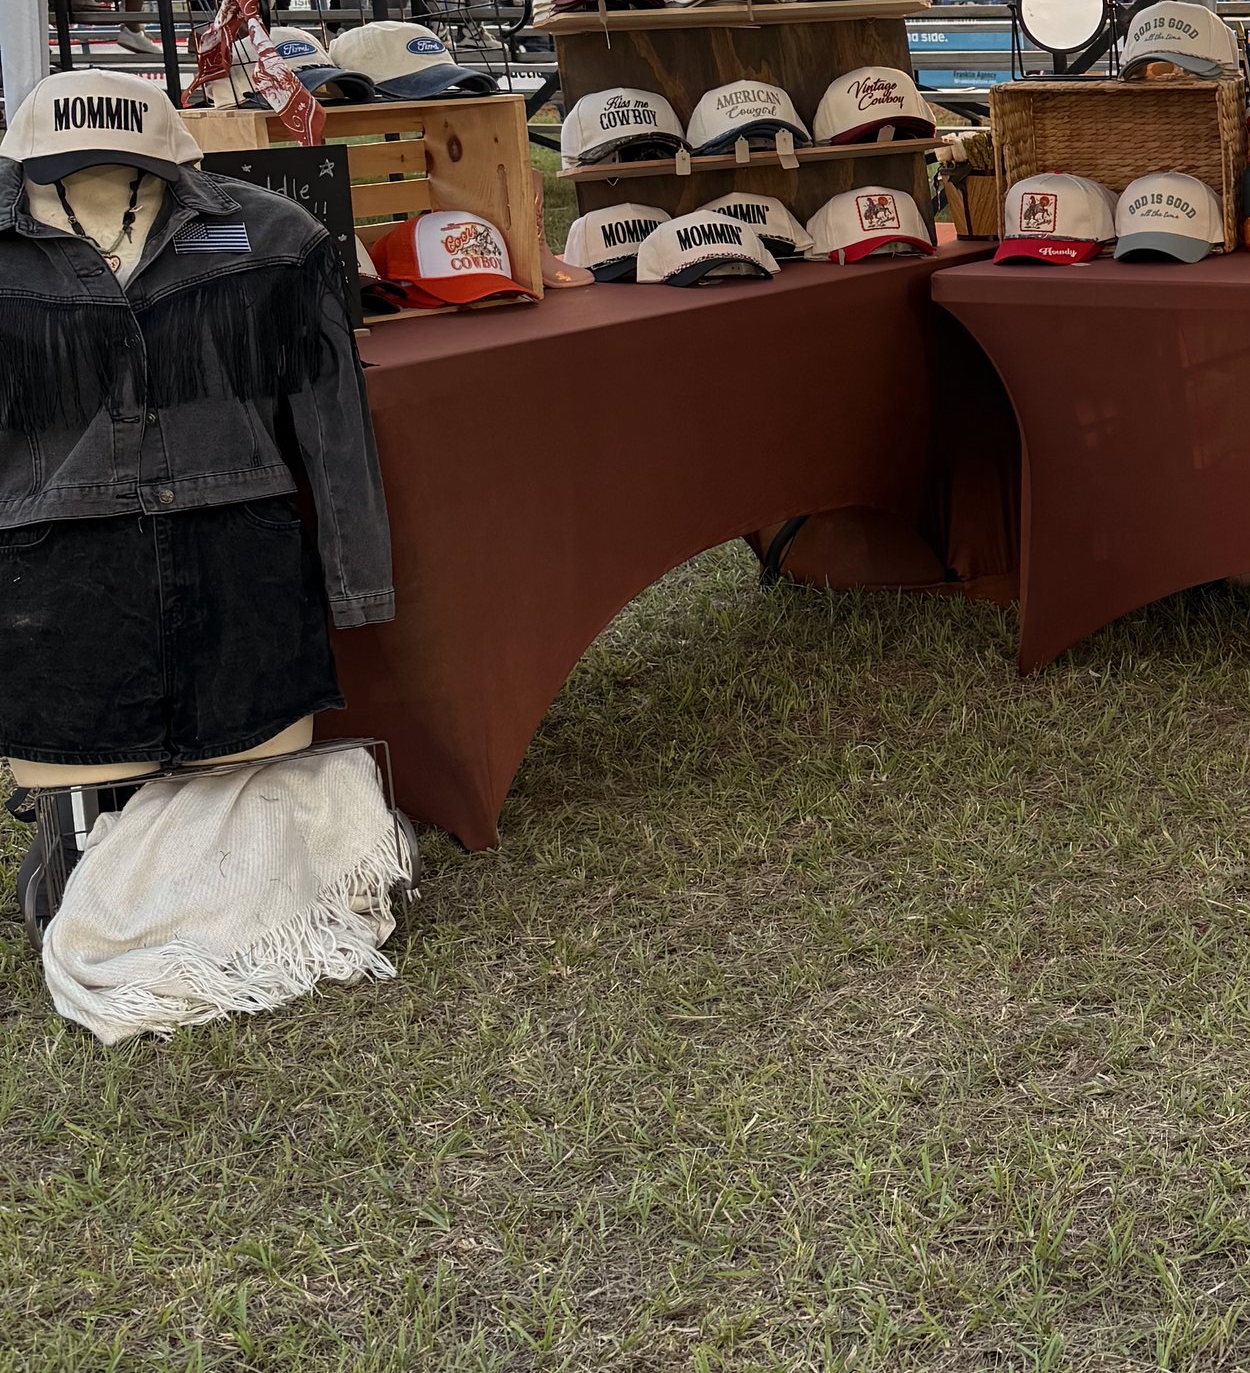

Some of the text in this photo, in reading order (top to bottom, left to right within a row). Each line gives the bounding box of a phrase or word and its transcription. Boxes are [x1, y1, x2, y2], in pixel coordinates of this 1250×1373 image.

[1133, 17, 1199, 42] GOD IS GOOD
[847, 77, 897, 99] Vintage
[604, 95, 649, 111] Kiss me
[716, 89, 781, 110] AMERICAN
[858, 90, 905, 111] Cowboy
[53, 96, 149, 134] MOMMIN'
[599, 108, 659, 130] COWBOY
[726, 104, 777, 119] Cowgirl
[711, 203, 769, 225] OMMIN'
[1128, 193, 1196, 219] GOD IS GOOD
[442, 225, 477, 254] Coors
[677, 223, 743, 252] MOMMIN'
[1039, 247, 1077, 257] Howdy
[451, 257, 503, 271] COWBOY
